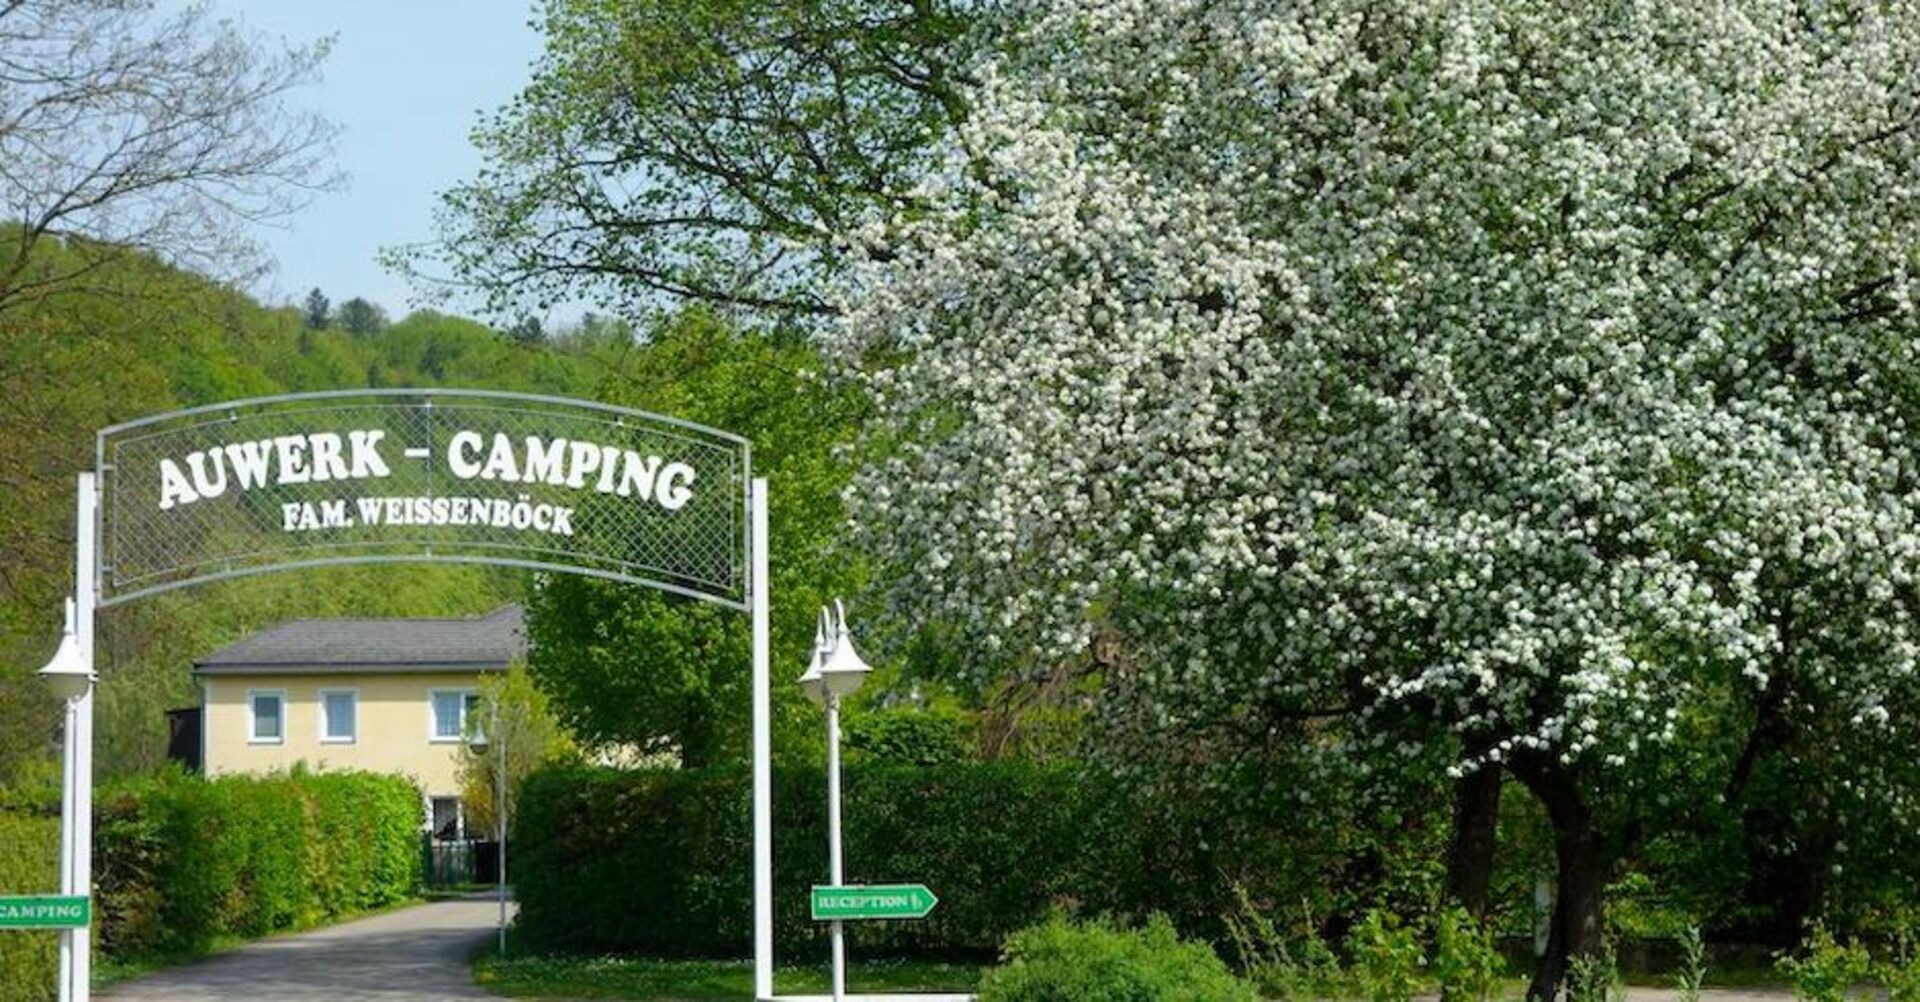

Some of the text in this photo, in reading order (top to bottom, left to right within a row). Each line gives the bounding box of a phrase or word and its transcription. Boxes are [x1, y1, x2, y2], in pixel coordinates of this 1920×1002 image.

[158, 430, 390, 509] AUWERK
[447, 431, 696, 510] CAMPING
[282, 494, 575, 536] FAM. WEISSENBÖCK
[818, 894, 907, 909] RECEPTION
